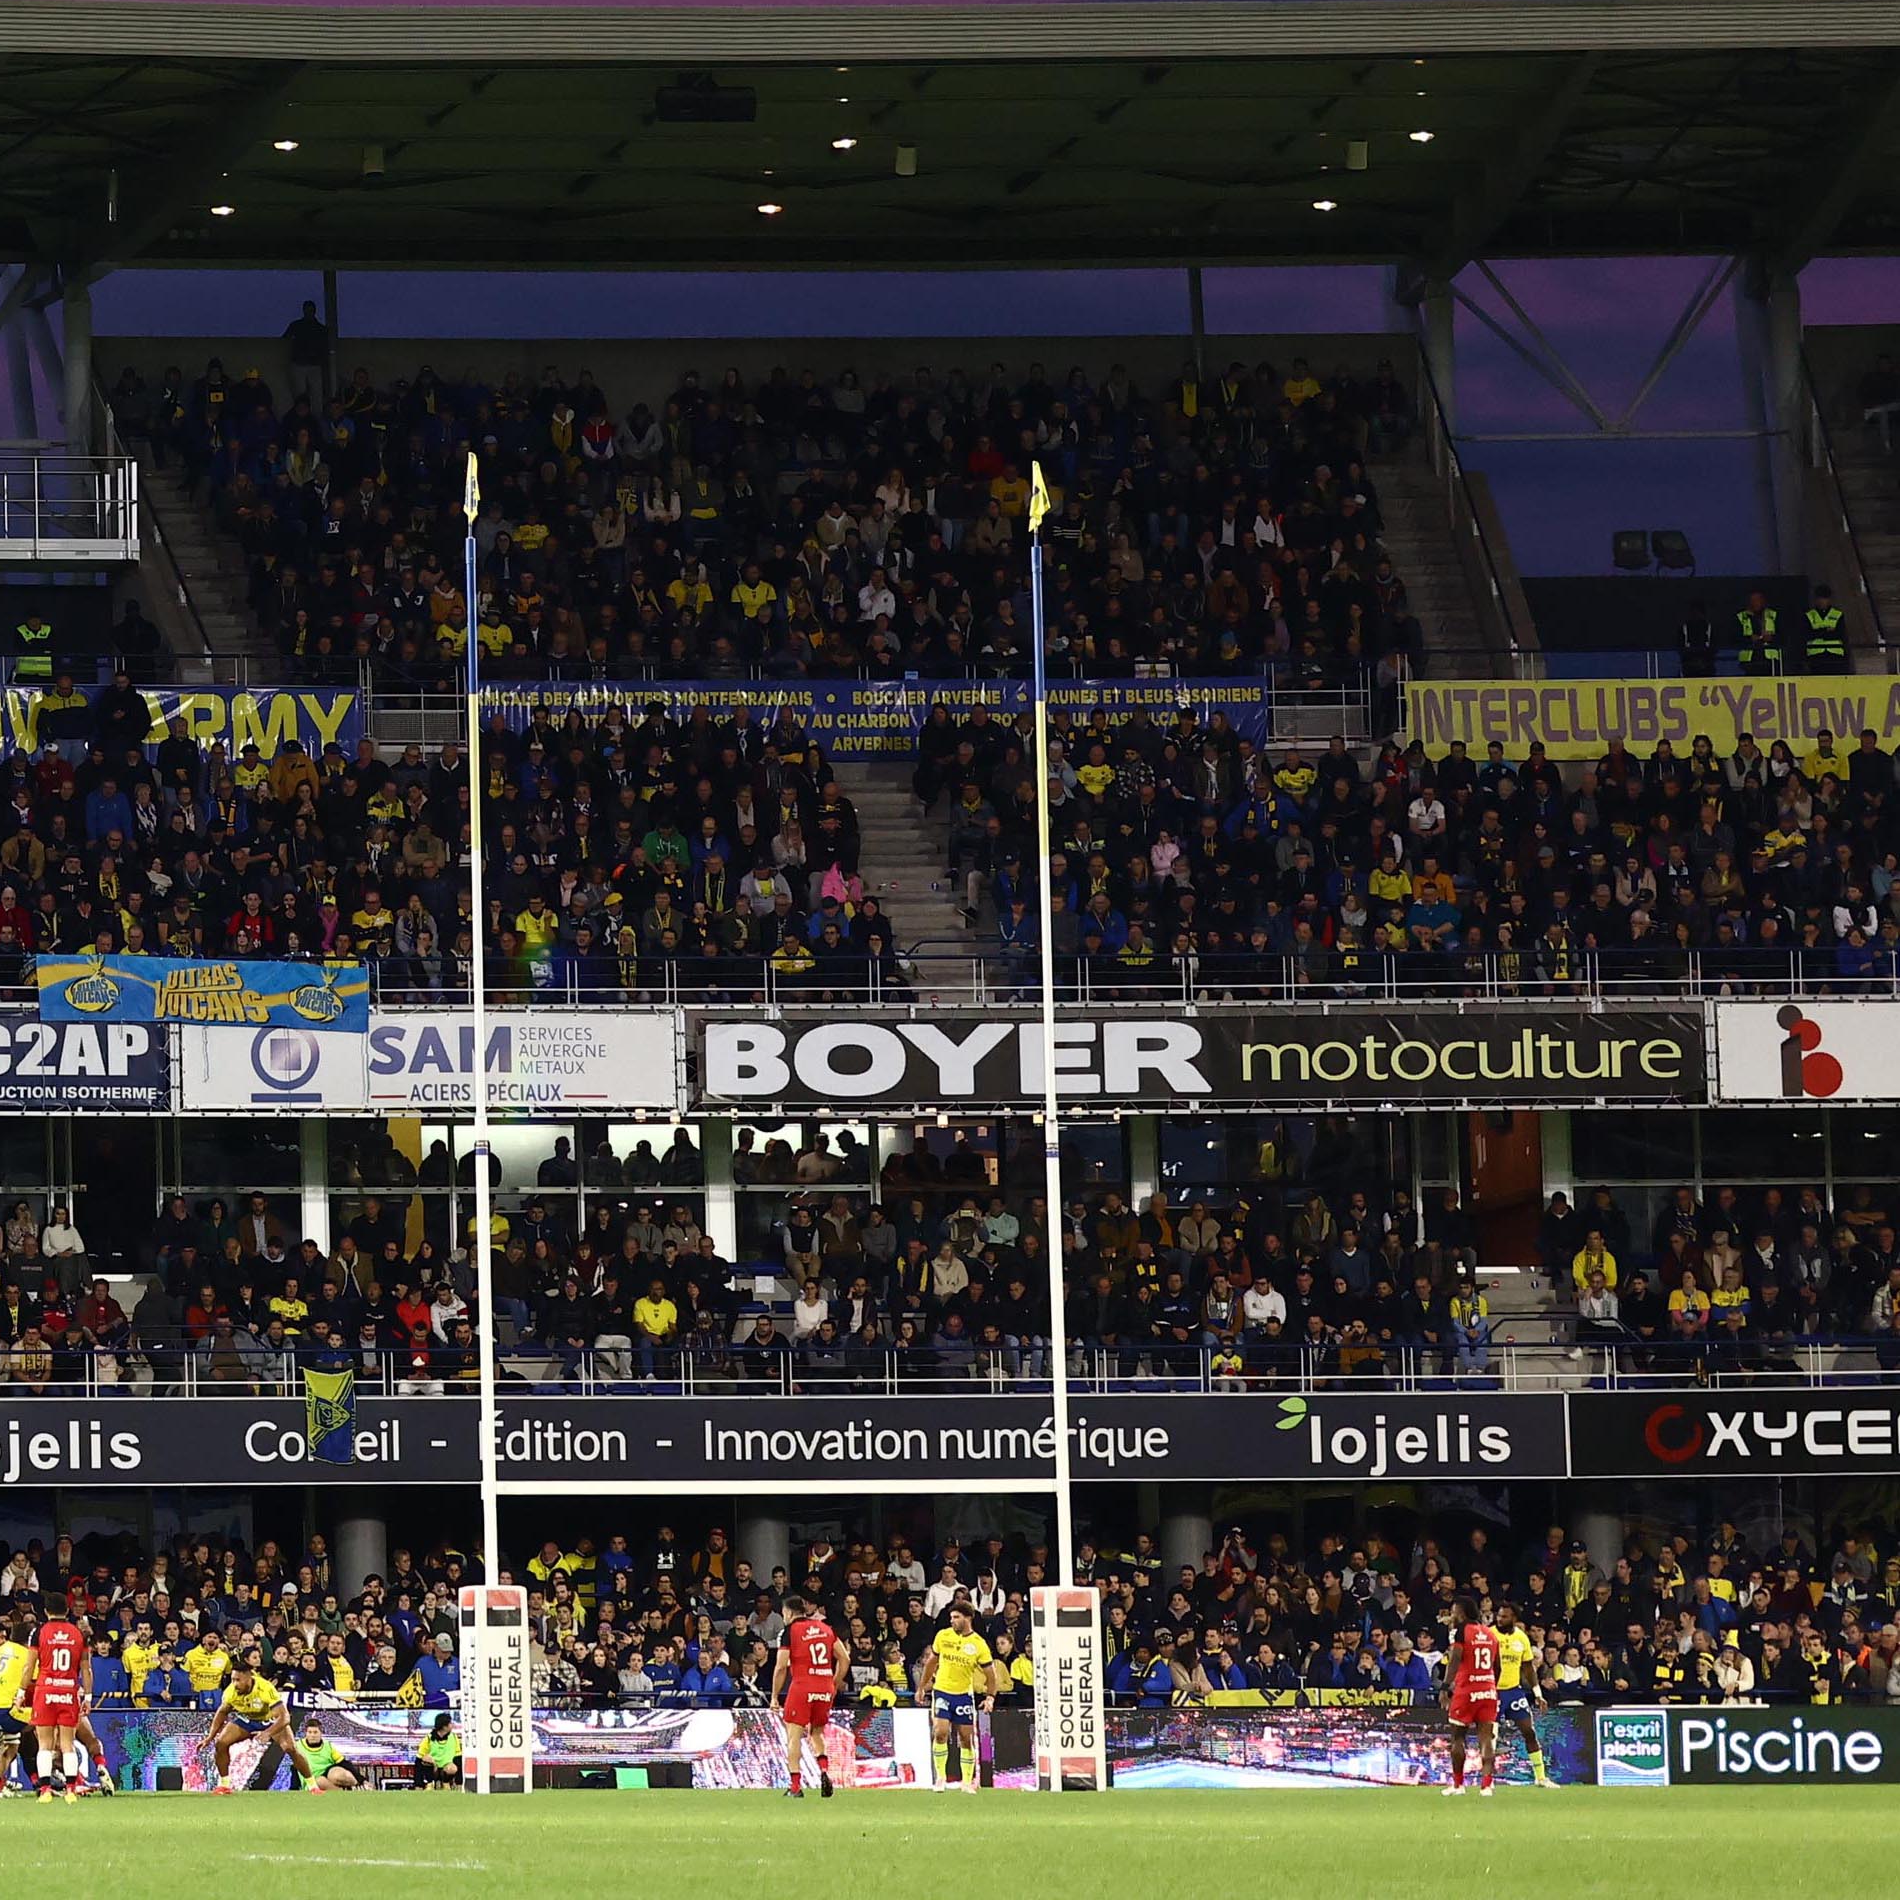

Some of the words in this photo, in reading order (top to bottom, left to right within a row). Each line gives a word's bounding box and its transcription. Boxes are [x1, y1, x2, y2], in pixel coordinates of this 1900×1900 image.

[543, 691, 571, 707] DES
[677, 690, 814, 706] MONTFERRANDAIS
[1102, 689, 1122, 704] ET
[1126, 688, 1174, 704] BLEUS
[812, 713, 833, 729] AU
[837, 713, 910, 729] CHARBON
[1412, 687, 1688, 743] INTERCLUBS
[832, 736, 912, 752] ARVERNES
[167, 963, 244, 991] ULTRAS
[153, 980, 271, 1024] VULCANS
[519, 1026, 593, 1042] SERVICES
[368, 1025, 513, 1075] SAM
[519, 1042, 607, 1059] AUVERGNE
[704, 1020, 1213, 1097] BOYER
[1241, 1028, 1683, 1081] motoculture
[519, 1059, 586, 1075] METAUX
[61, 1085, 158, 1101] ISOTHERME
[409, 1083, 471, 1102] ACIERS
[486, 1080, 562, 1102] PÉCIAUX
[245, 1420, 400, 1462] Coeil
[704, 1419, 928, 1462] Innovation
[938, 1415, 1169, 1465] numérique
[1644, 1404, 1900, 1464] OXYCE
[1309, 1414, 1512, 1478] lojelis
[51, 1648, 72, 1672] 10
[808, 1642, 829, 1666] 12
[1473, 1647, 1492, 1670] 13
[45, 1692, 74, 1705] yack
[489, 1656, 504, 1749] SOCIETE
[507, 1634, 524, 1749] GENERALE
[807, 1691, 833, 1703] yack
[1059, 1657, 1075, 1749] SOCIETE
[1078, 1635, 1095, 1749] GENERALE
[1469, 1689, 1498, 1703] yack
[1602, 1721, 1662, 1742] l'esprit
[1602, 1740, 1662, 1758] piscine
[1681, 1717, 1883, 1774] Piscine
